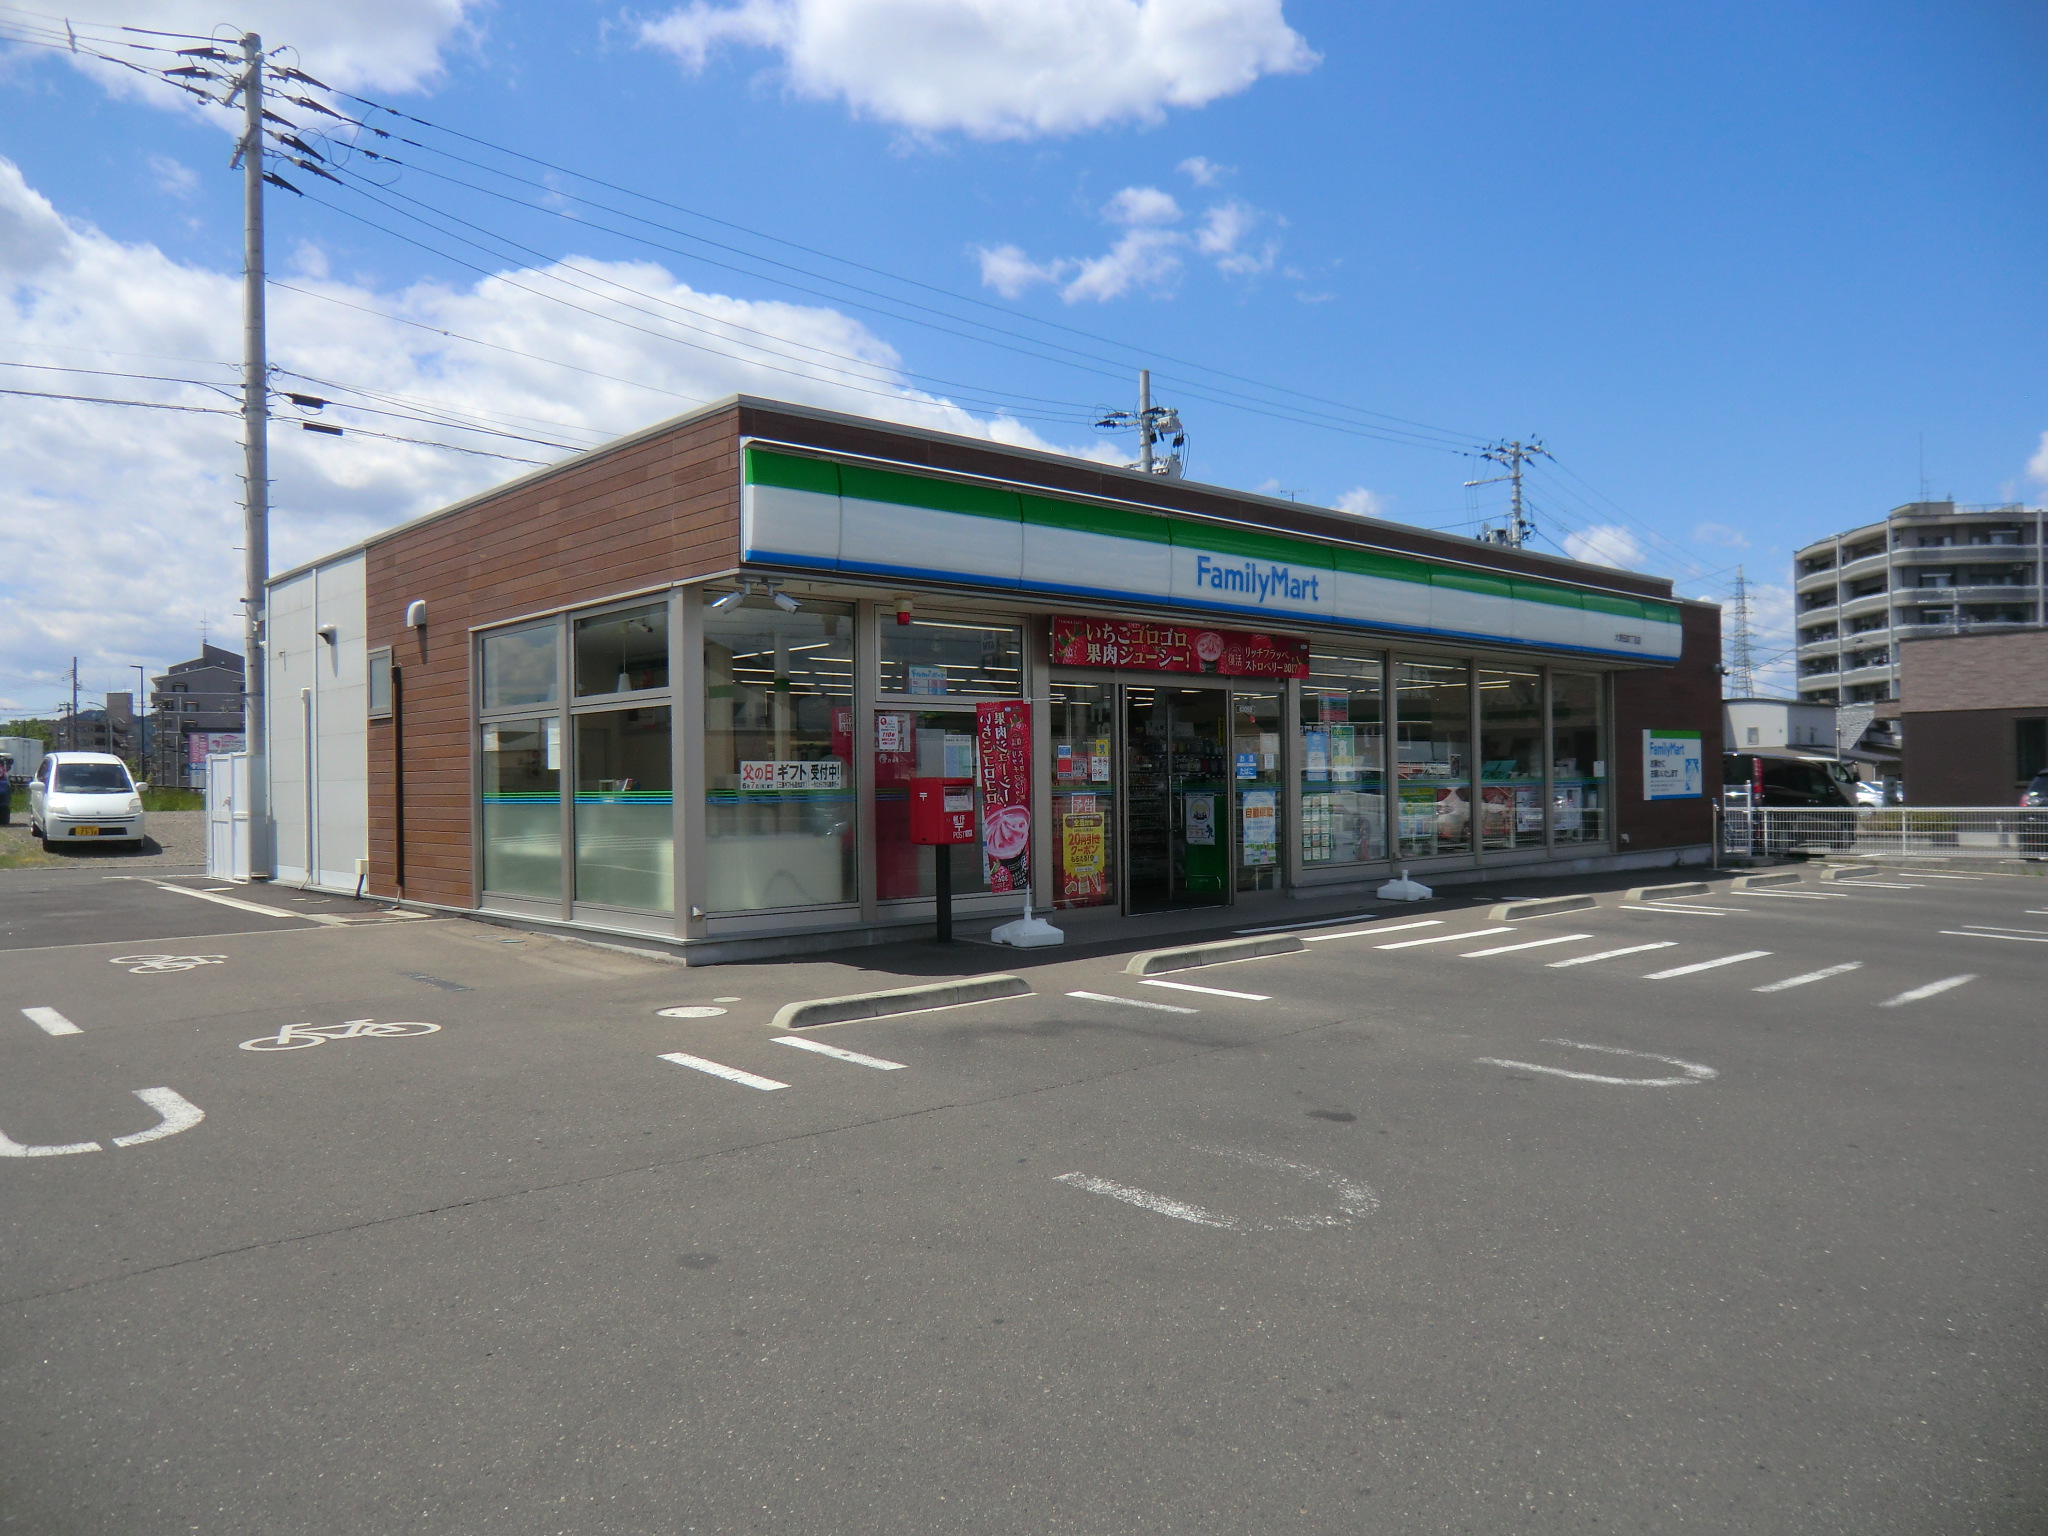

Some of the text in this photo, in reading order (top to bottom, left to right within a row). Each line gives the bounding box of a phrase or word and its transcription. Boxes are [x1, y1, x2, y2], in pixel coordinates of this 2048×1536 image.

[1197, 555, 1319, 603] FamilyMart
[1086, 623, 1192, 651] いちごゴロゴロ、
[1086, 642, 1190, 669] 果肉ジューシー!
[1650, 742, 1685, 757] FamilyMart
[743, 764, 840, 781] 父の日 ギフト 受付中!
[1073, 798, 1094, 812] 予告
[952, 814, 966, 824] 郵便
[952, 831, 965, 839] POST
[1068, 833, 1101, 846] 20円引き
[1071, 845, 1099, 855] クーポン
